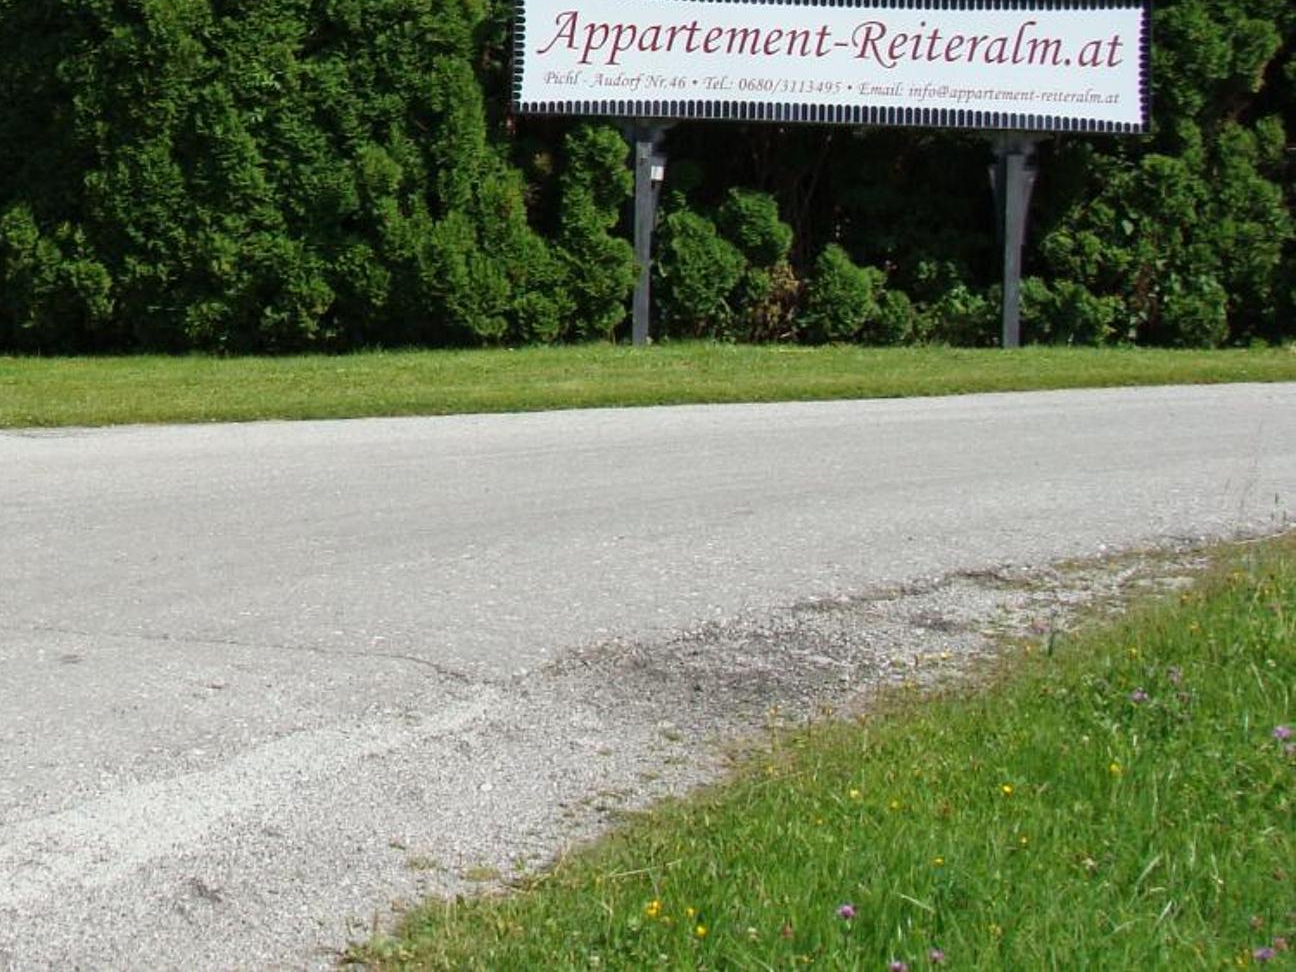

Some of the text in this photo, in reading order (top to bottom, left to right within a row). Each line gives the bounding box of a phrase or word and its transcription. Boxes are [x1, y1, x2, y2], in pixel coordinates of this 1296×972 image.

[536, 10, 1124, 68] Appartement-Reiteralm.at
[544, 71, 580, 86] Pichl
[590, 73, 642, 92] Audorf
[738, 78, 842, 94] 0680/3113495
[858, 81, 902, 97] Email:
[908, 84, 1120, 105] info@appartement-reiteralm.at
